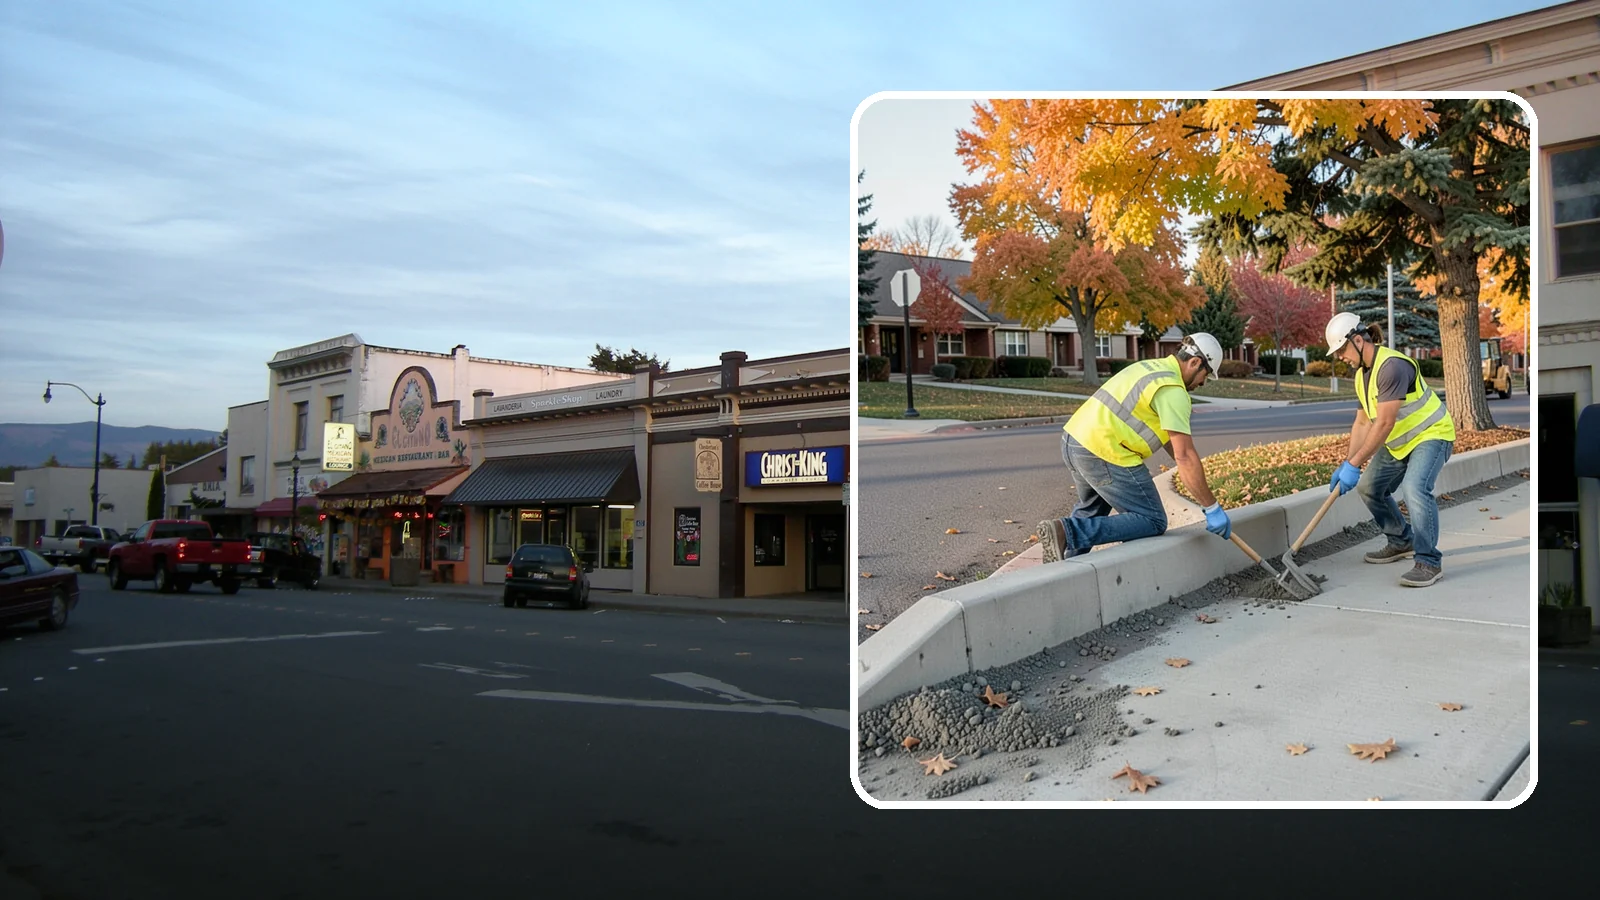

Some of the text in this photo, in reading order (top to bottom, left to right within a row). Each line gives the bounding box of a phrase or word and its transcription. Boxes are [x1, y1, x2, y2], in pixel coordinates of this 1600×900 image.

[595, 389, 623, 400] LAUNDRY
[493, 402, 522, 412] LAVANDERIA
[530, 395, 582, 408] Sparkle Shop
[373, 450, 450, 464] MEXICAN RESTAURANT BAR
[760, 450, 827, 478] CHRIST KING
